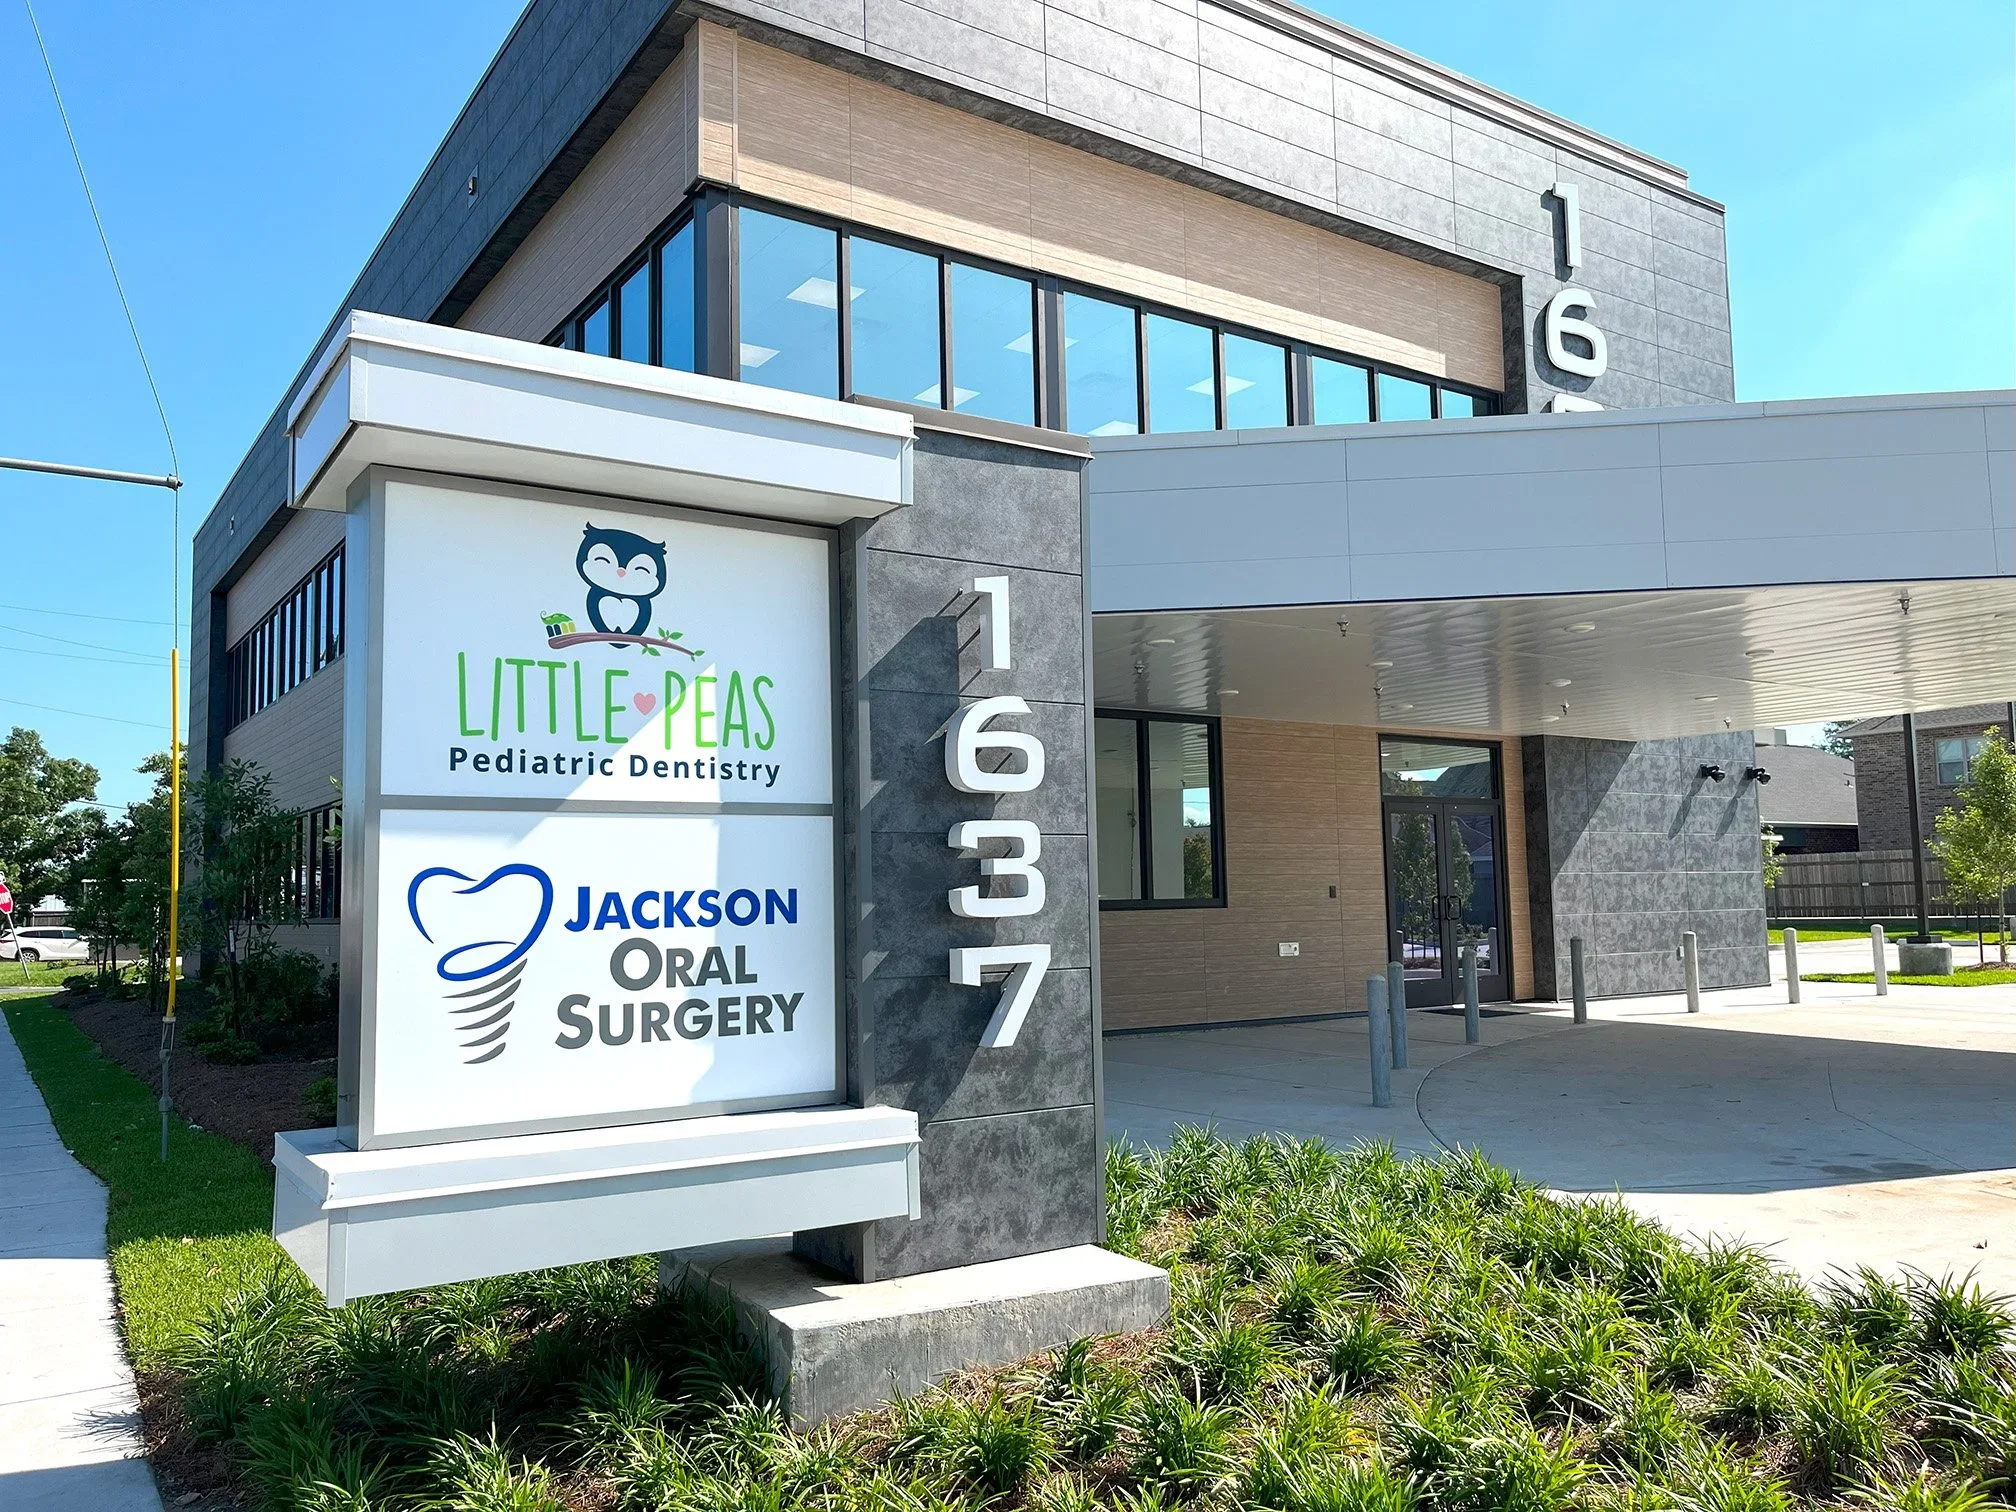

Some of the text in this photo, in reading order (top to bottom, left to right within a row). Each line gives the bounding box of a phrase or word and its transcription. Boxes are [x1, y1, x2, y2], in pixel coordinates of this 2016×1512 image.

[1545, 181, 1608, 413] 16
[457, 652, 776, 751] LITTLE PEAS
[449, 746, 781, 788] Pediatric Dentistry
[944, 575, 1051, 1048] 1637
[563, 886, 798, 932] JACKSON
[609, 937, 758, 991] ORAL
[555, 993, 805, 1050] SURGERY
